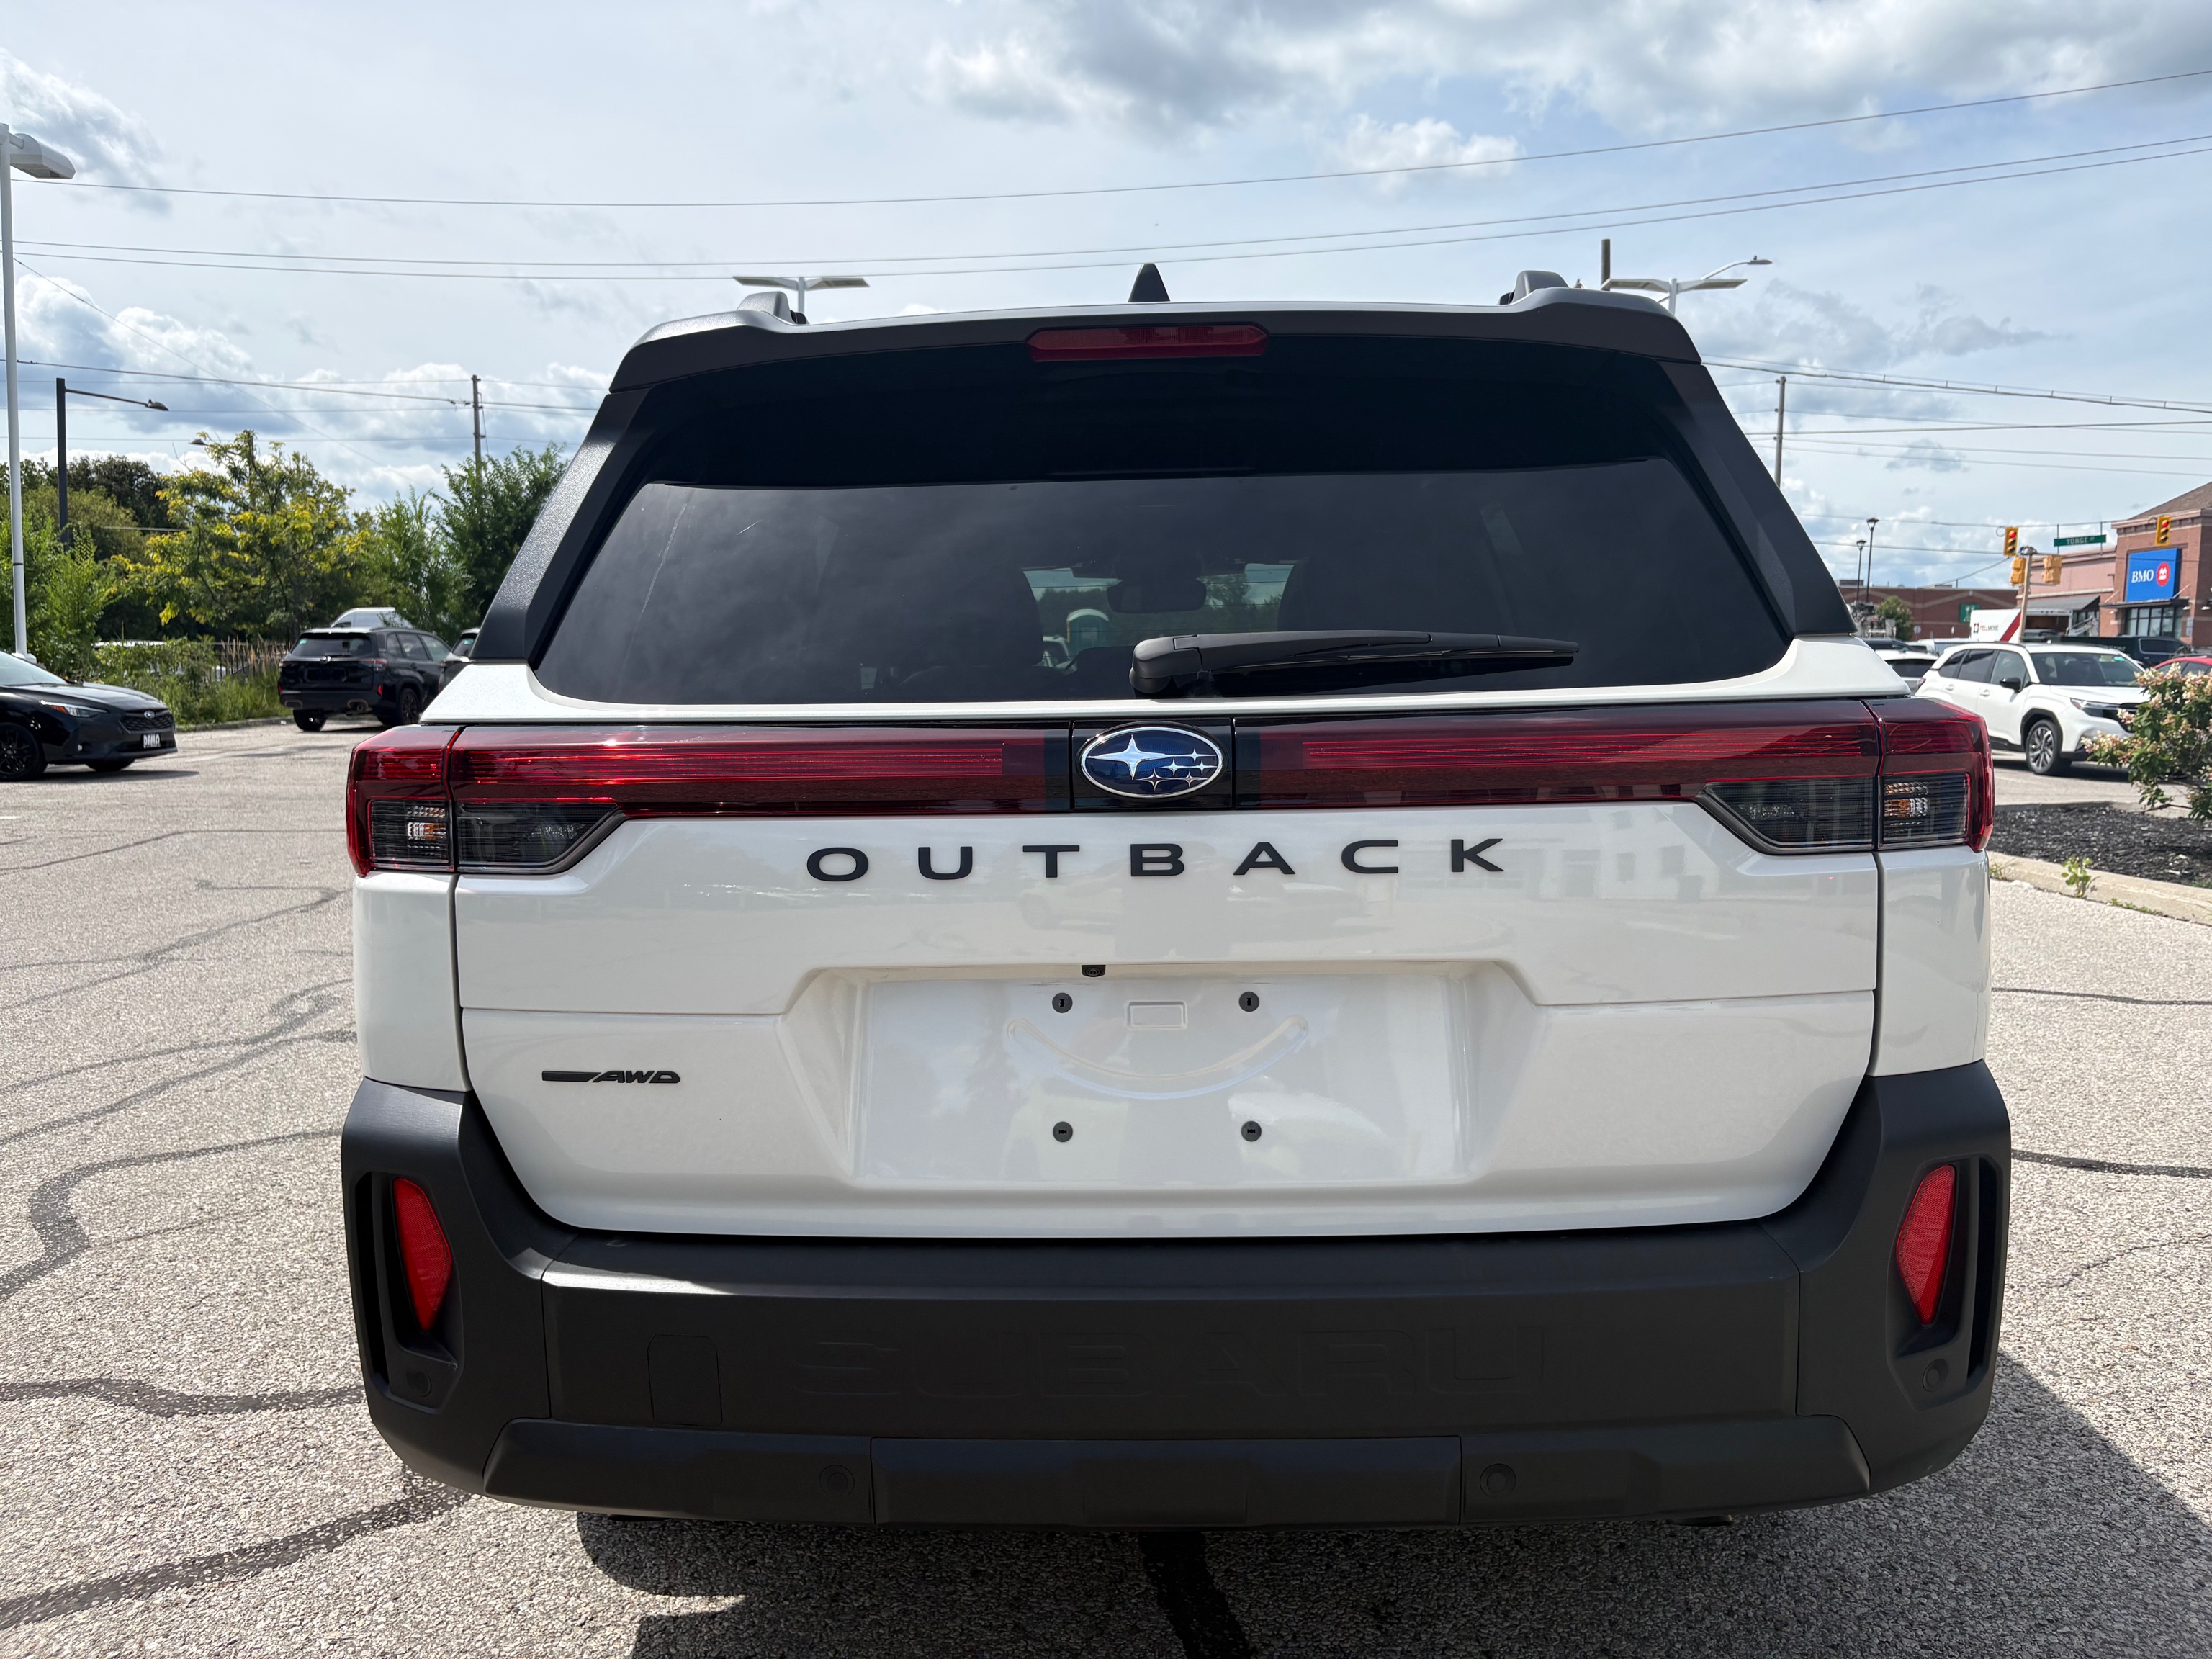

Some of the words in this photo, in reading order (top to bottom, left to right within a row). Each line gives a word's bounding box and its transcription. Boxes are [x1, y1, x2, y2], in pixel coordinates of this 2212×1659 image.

[2131, 569, 2154, 583] BMO
[806, 837, 1505, 882] OUTBACK
[591, 1070, 681, 1084] AWD
[791, 1326, 1545, 1398] SUBARU
